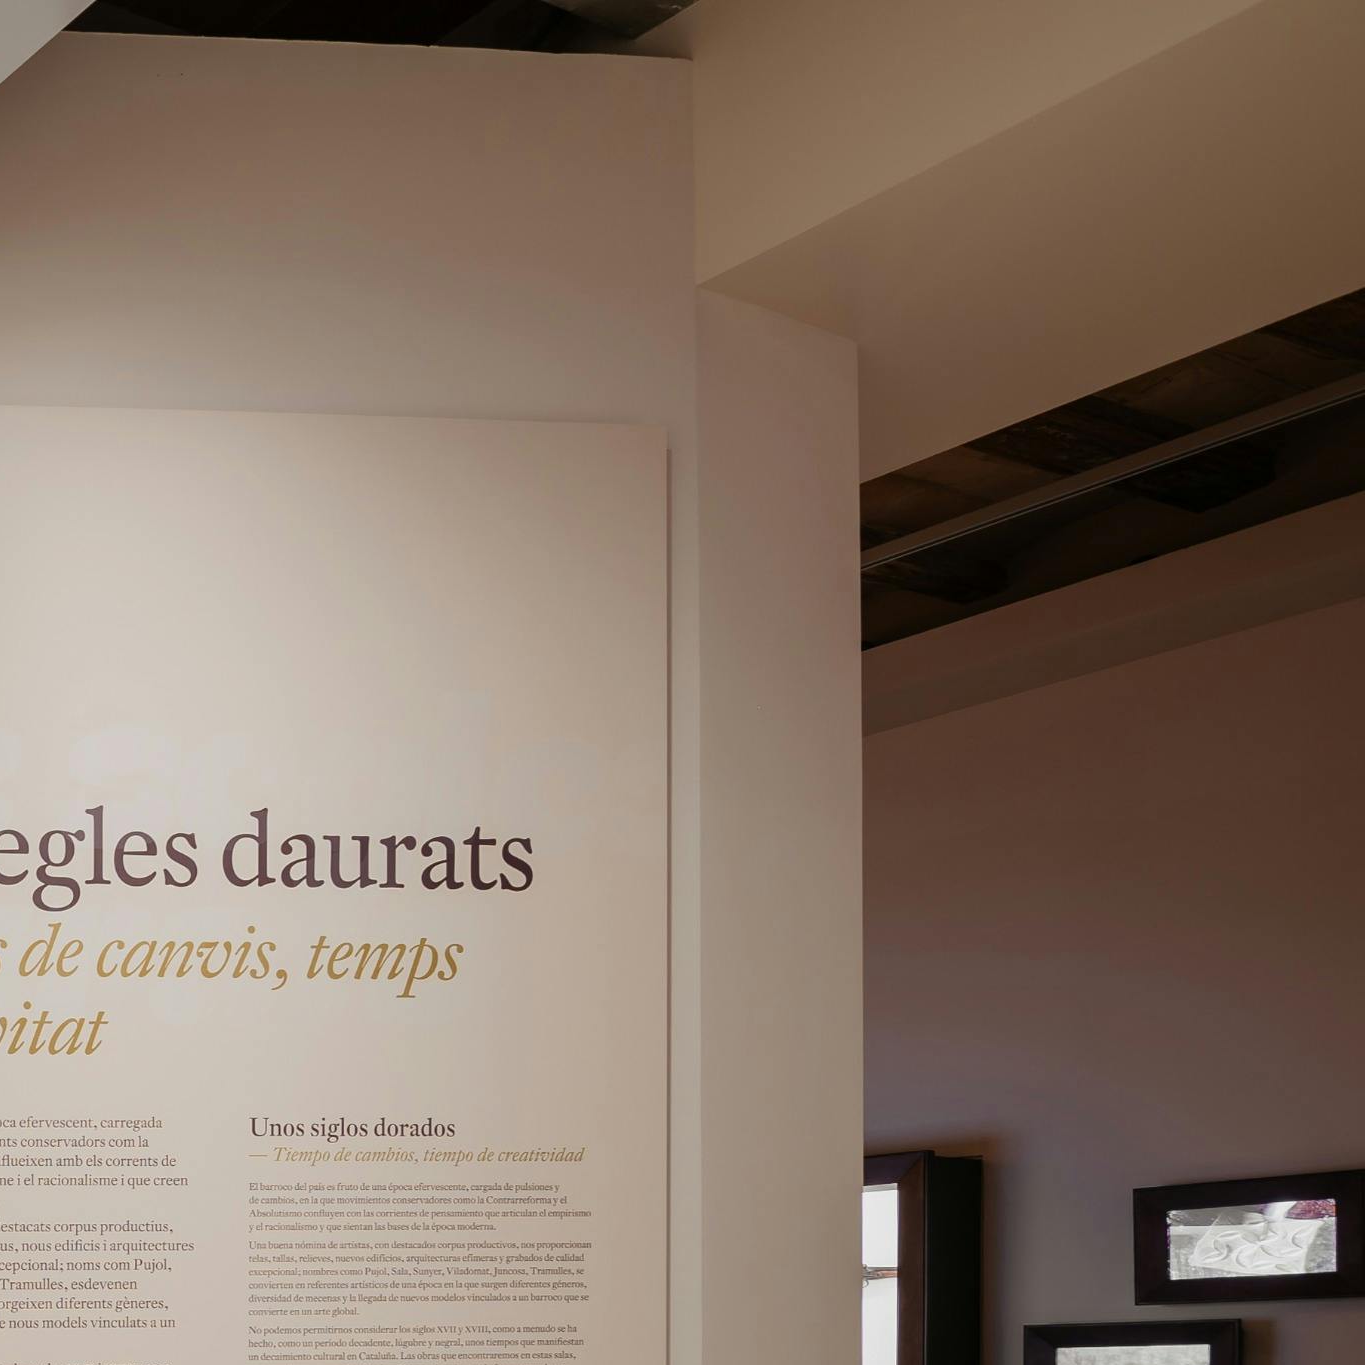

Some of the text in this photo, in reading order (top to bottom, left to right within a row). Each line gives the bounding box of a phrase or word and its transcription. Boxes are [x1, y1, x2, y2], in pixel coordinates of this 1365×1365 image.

[222, 808, 533, 892] daurats
[19, 922, 83, 977] de
[96, 925, 288, 990] canvis,
[306, 935, 465, 998] temps
[19, 1115, 98, 1130] efervescent,
[100, 1115, 163, 1132] carregada
[249, 1117, 455, 1142] Unos siglos dorados
[21, 1134, 106, 1147] conservadors
[107, 1138, 136, 1147] com
[138, 1134, 149, 1147] la
[56, 1154, 84, 1167] amb
[86, 1154, 103, 1167] els
[105, 1154, 159, 1167] corrents
[161, 1153, 177, 1166] de
[272, 1147, 586, 1166] Tiempo de cambios, tiempo de creatividad
[23, 1173, 35, 1186] el
[37, 1173, 120, 1186] racionalisme
[127, 1177, 151, 1190] que
[153, 1177, 188, 1186] creen
